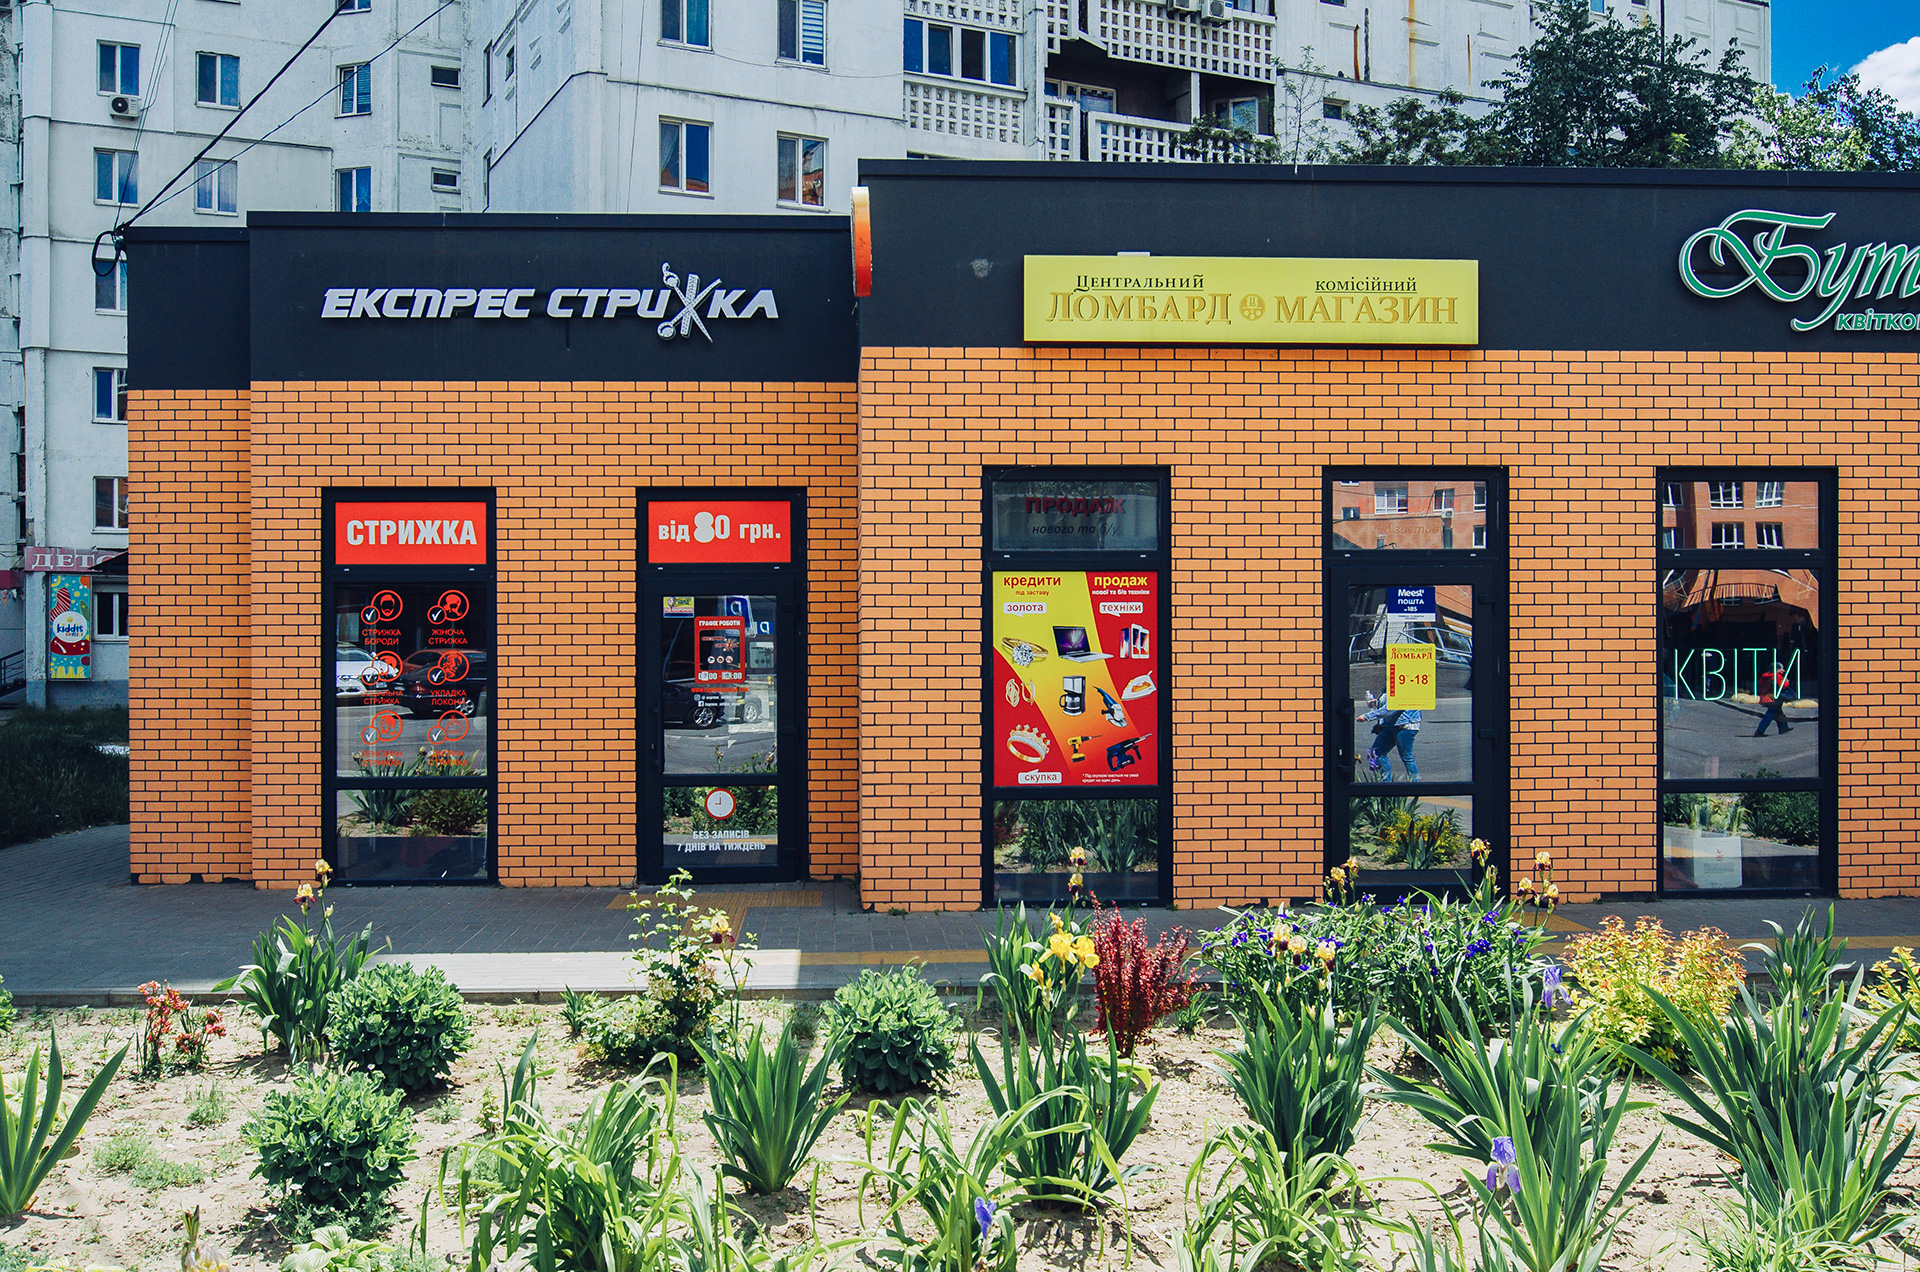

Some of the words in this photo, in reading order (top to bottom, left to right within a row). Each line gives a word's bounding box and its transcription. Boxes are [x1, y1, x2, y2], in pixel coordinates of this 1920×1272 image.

[1315, 276, 1417, 292] комісійний
[320, 288, 535, 319] ЕКСПРЕС
[547, 262, 779, 343] СТРИЖКА
[1046, 292, 1231, 325] ЛОМБАРД
[1273, 295, 1458, 324] МАГАЗИН
[1834, 308, 1920, 331] КВІТКО
[1025, 497, 1125, 517] ПРОДАЖ
[346, 519, 477, 545] СТРИЖКА
[658, 520, 690, 542] від
[693, 511, 730, 543] 80
[739, 523, 781, 543] грн.
[1032, 524, 1074, 534] нового
[1077, 524, 1096, 534] та
[1003, 576, 1061, 588] кредити
[1094, 576, 1148, 588] продаж
[1007, 604, 1044, 612] золота
[1102, 602, 1141, 612] техніки
[57, 623, 83, 633] kiddis
[364, 637, 399, 645] БОРОДИ
[428, 637, 468, 645] СТРИЖКА
[1391, 652, 1432, 660] ЛОМБАРД
[1674, 648, 1801, 700] КВІТИ
[361, 759, 401, 767] СТРИЖКА
[1024, 774, 1057, 782] скупка
[692, 830, 709, 839] БЕЗ
[711, 830, 750, 839] ЗАПИСІВ
[676, 843, 681, 852] 7
[684, 843, 706, 853] ДНІВ
[709, 843, 720, 851] НА
[723, 842, 766, 852] ТИЖДЕНЬ
